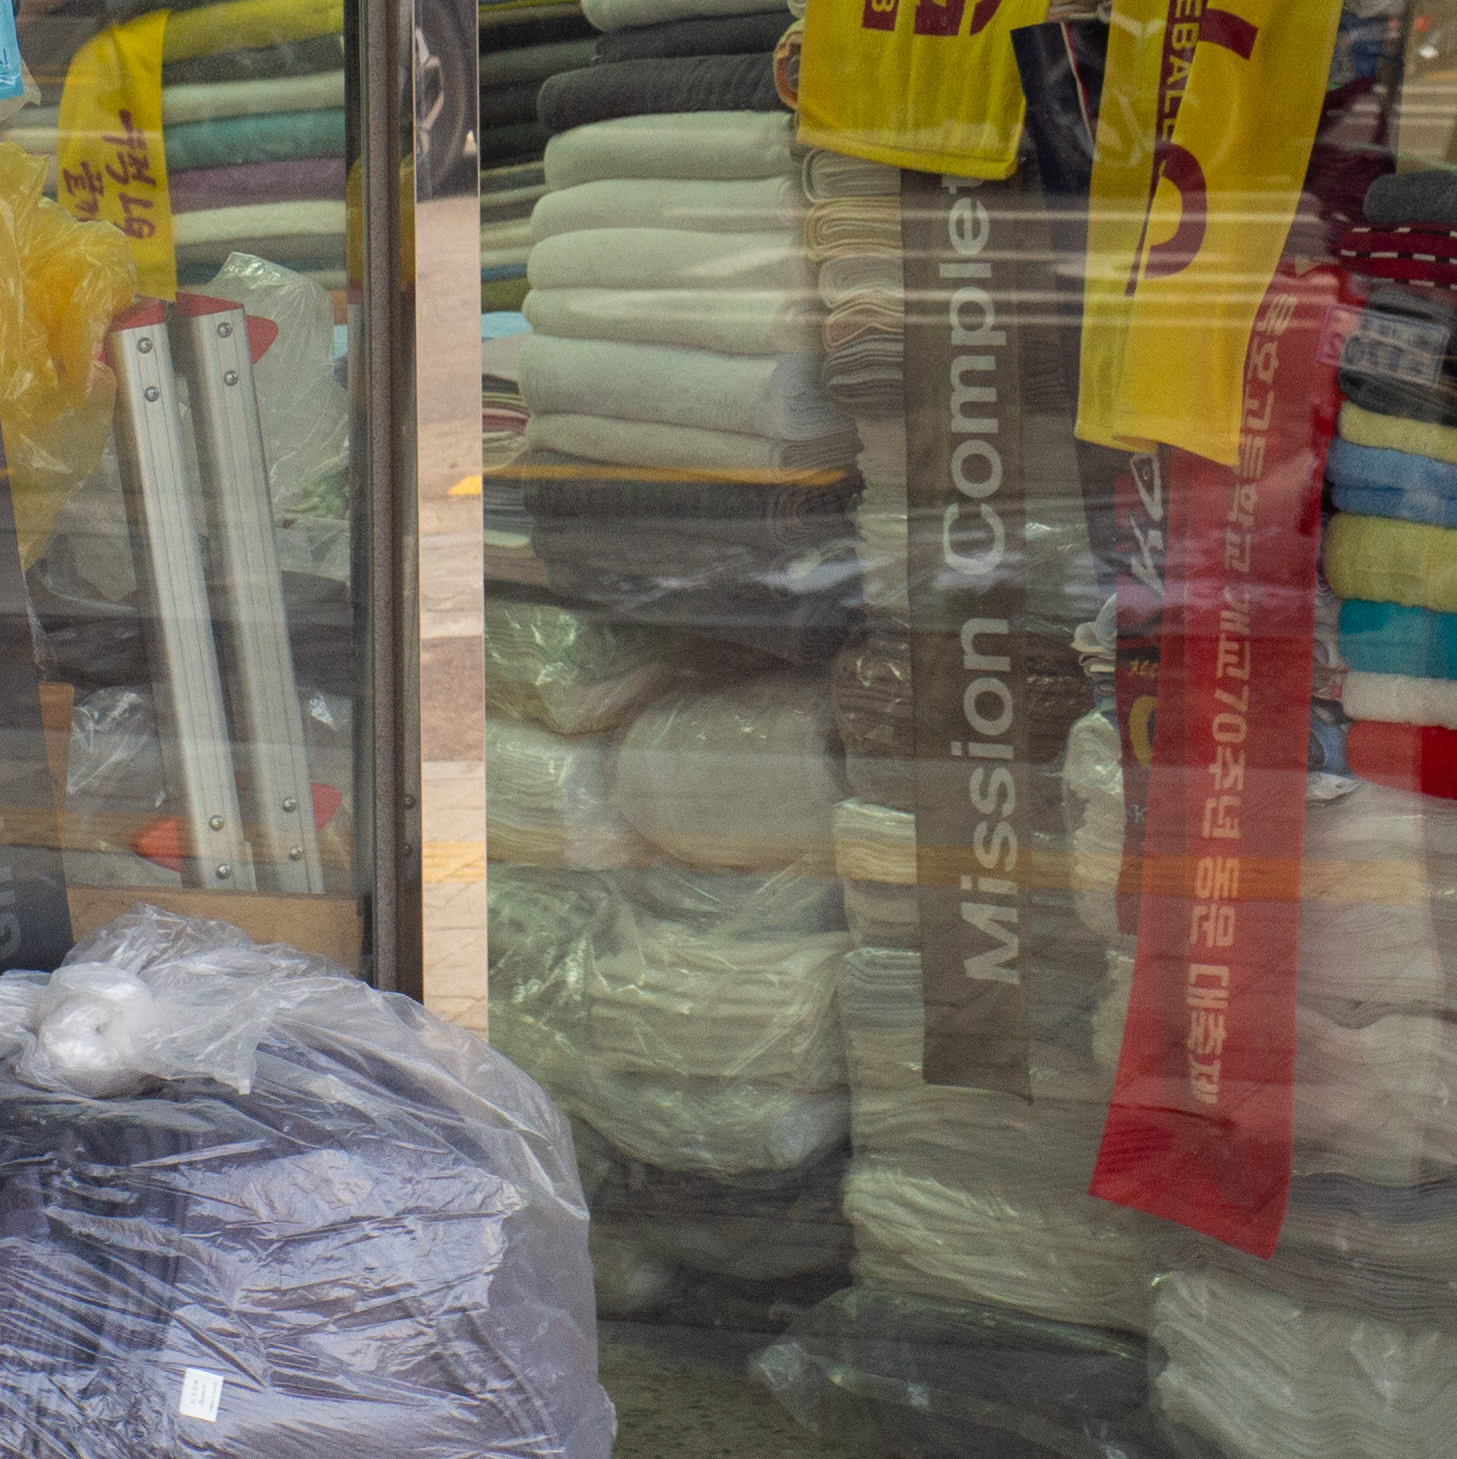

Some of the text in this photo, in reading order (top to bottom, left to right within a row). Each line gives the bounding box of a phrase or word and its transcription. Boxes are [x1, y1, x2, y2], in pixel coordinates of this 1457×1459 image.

[950, 614, 1022, 988] Mission
[1200, 583, 1253, 841] 개교70주년
[1187, 855, 1242, 949] 동문
[1185, 961, 1232, 1107] 대축제
